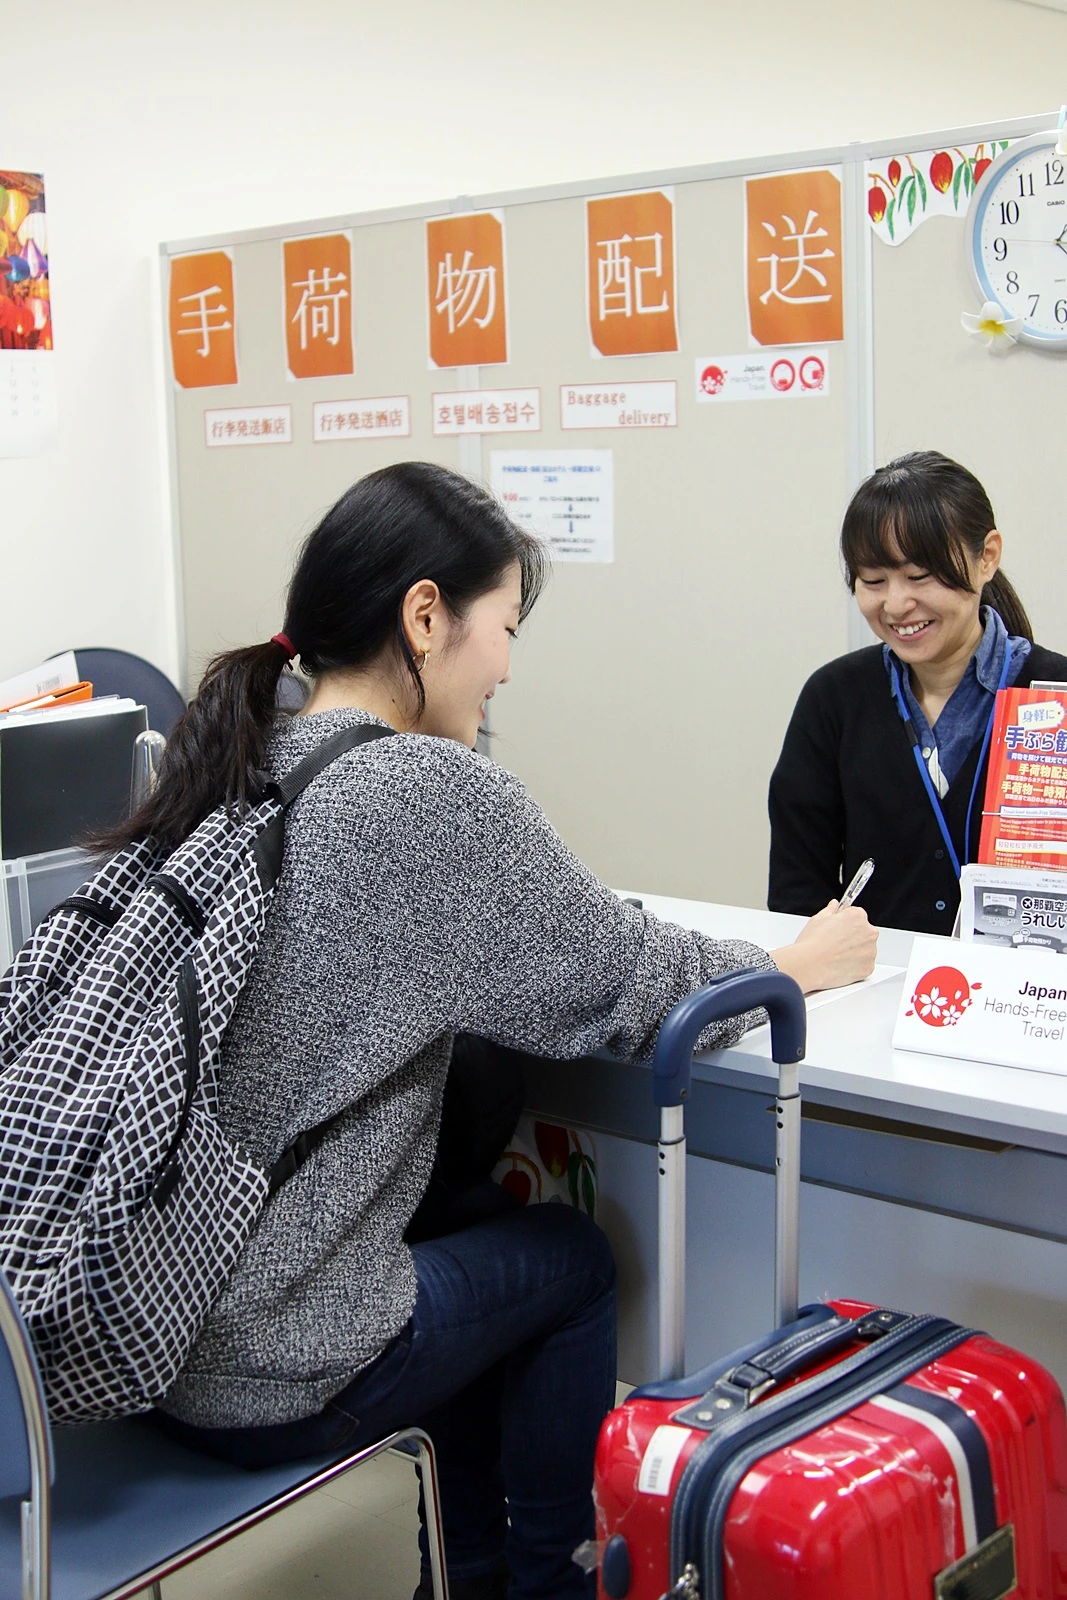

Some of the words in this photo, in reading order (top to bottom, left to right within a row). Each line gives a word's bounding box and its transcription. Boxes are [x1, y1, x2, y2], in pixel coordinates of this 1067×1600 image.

[1019, 172, 1036, 197] 11
[1044, 160, 1064, 186] 12
[1000, 200, 1020, 225] 10
[994, 237, 1008, 261] 9
[1006, 270, 1020, 294] 8
[1027, 294, 1040, 317] 7
[1054, 299, 1067, 323] 6
[567, 390, 626, 406] Baggage
[437, 401, 536, 425] 호텔배송접수
[618, 410, 671, 427] delivery
[1023, 708, 1055, 723] 身軽に
[1001, 781, 1067, 800] 手荷物一時預
[1019, 981, 1067, 1000] Japan
[984, 997, 1067, 1022] Hands-Free
[1022, 1020, 1064, 1040] Travel
